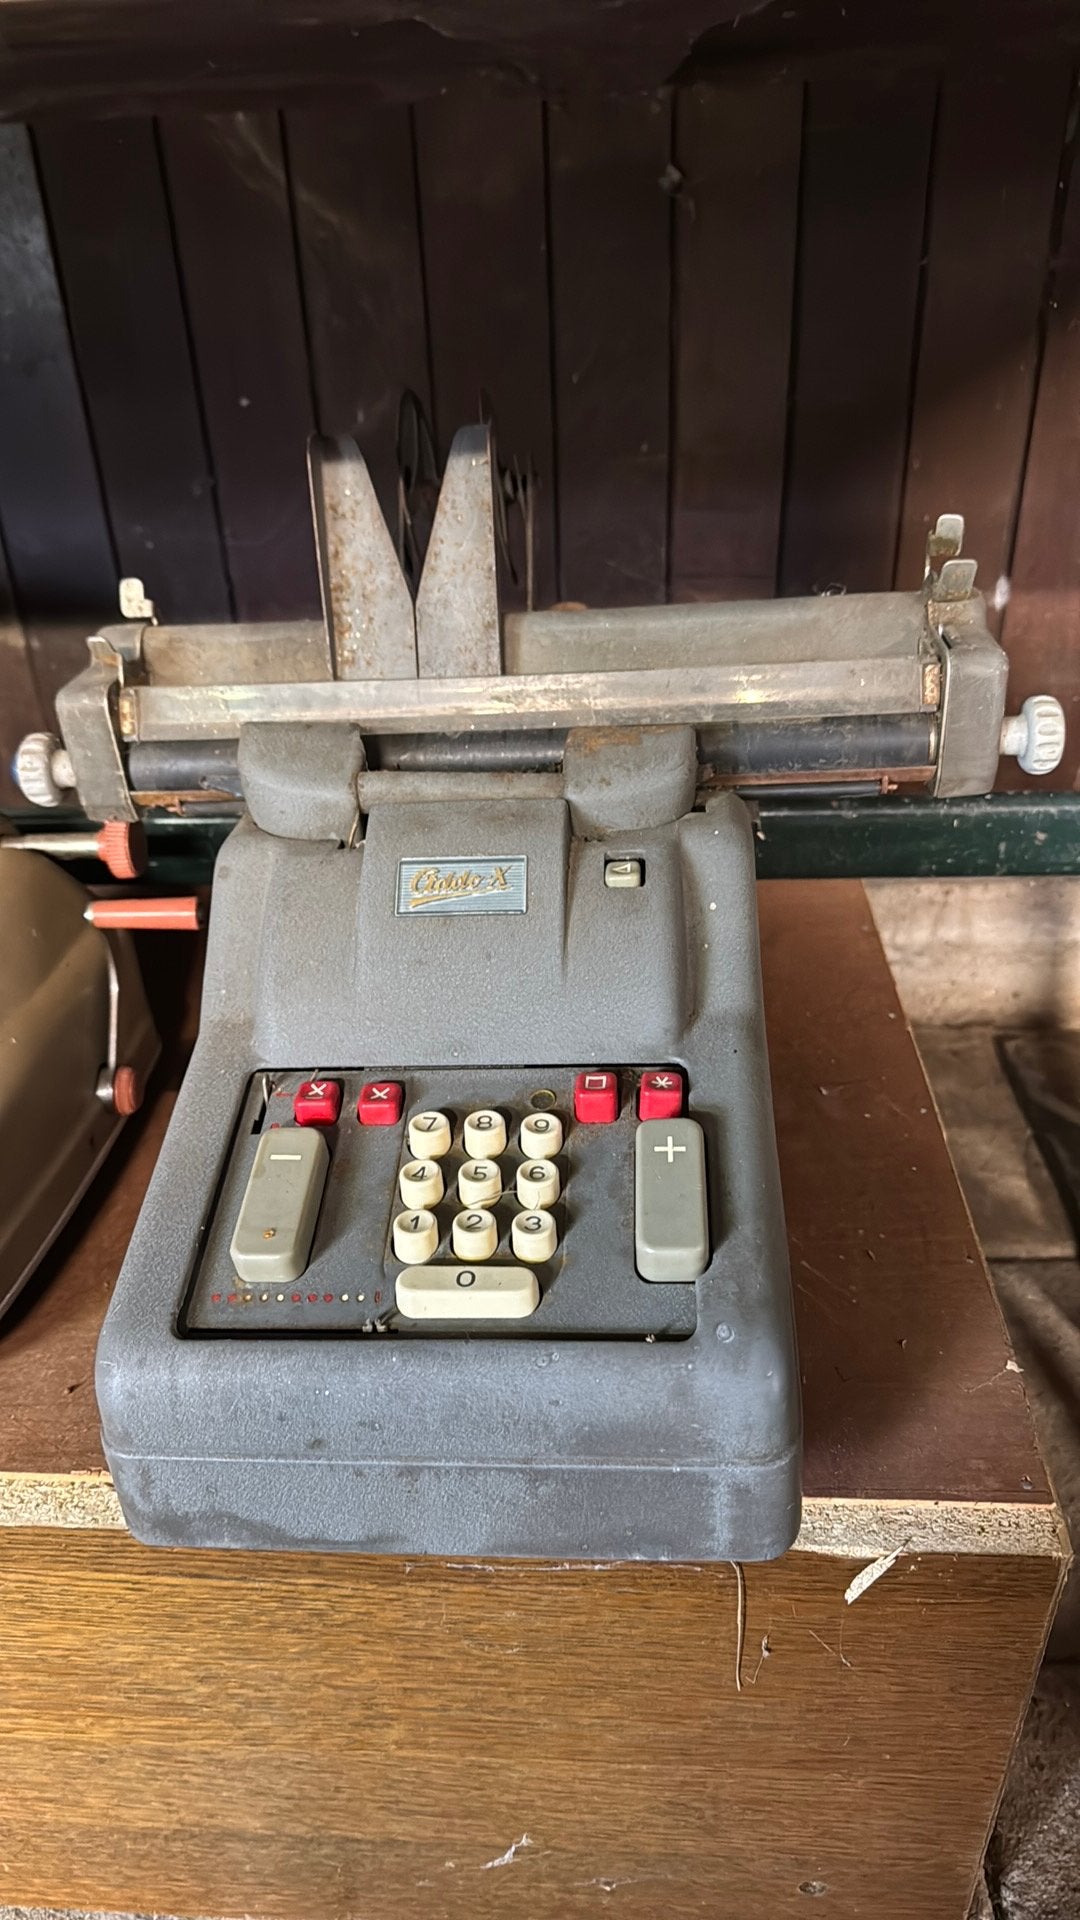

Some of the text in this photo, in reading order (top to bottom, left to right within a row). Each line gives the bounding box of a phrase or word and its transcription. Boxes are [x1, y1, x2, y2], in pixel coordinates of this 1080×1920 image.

[422, 1116, 438, 1131] 7
[476, 1115, 493, 1130] 8
[534, 1119, 550, 1132] 9
[411, 1166, 427, 1181] 4
[472, 1166, 487, 1180] 5
[529, 1166, 545, 1179] 6
[410, 1215, 420, 1230] 1
[466, 1214, 483, 1230] 2
[524, 1216, 542, 1231] 3
